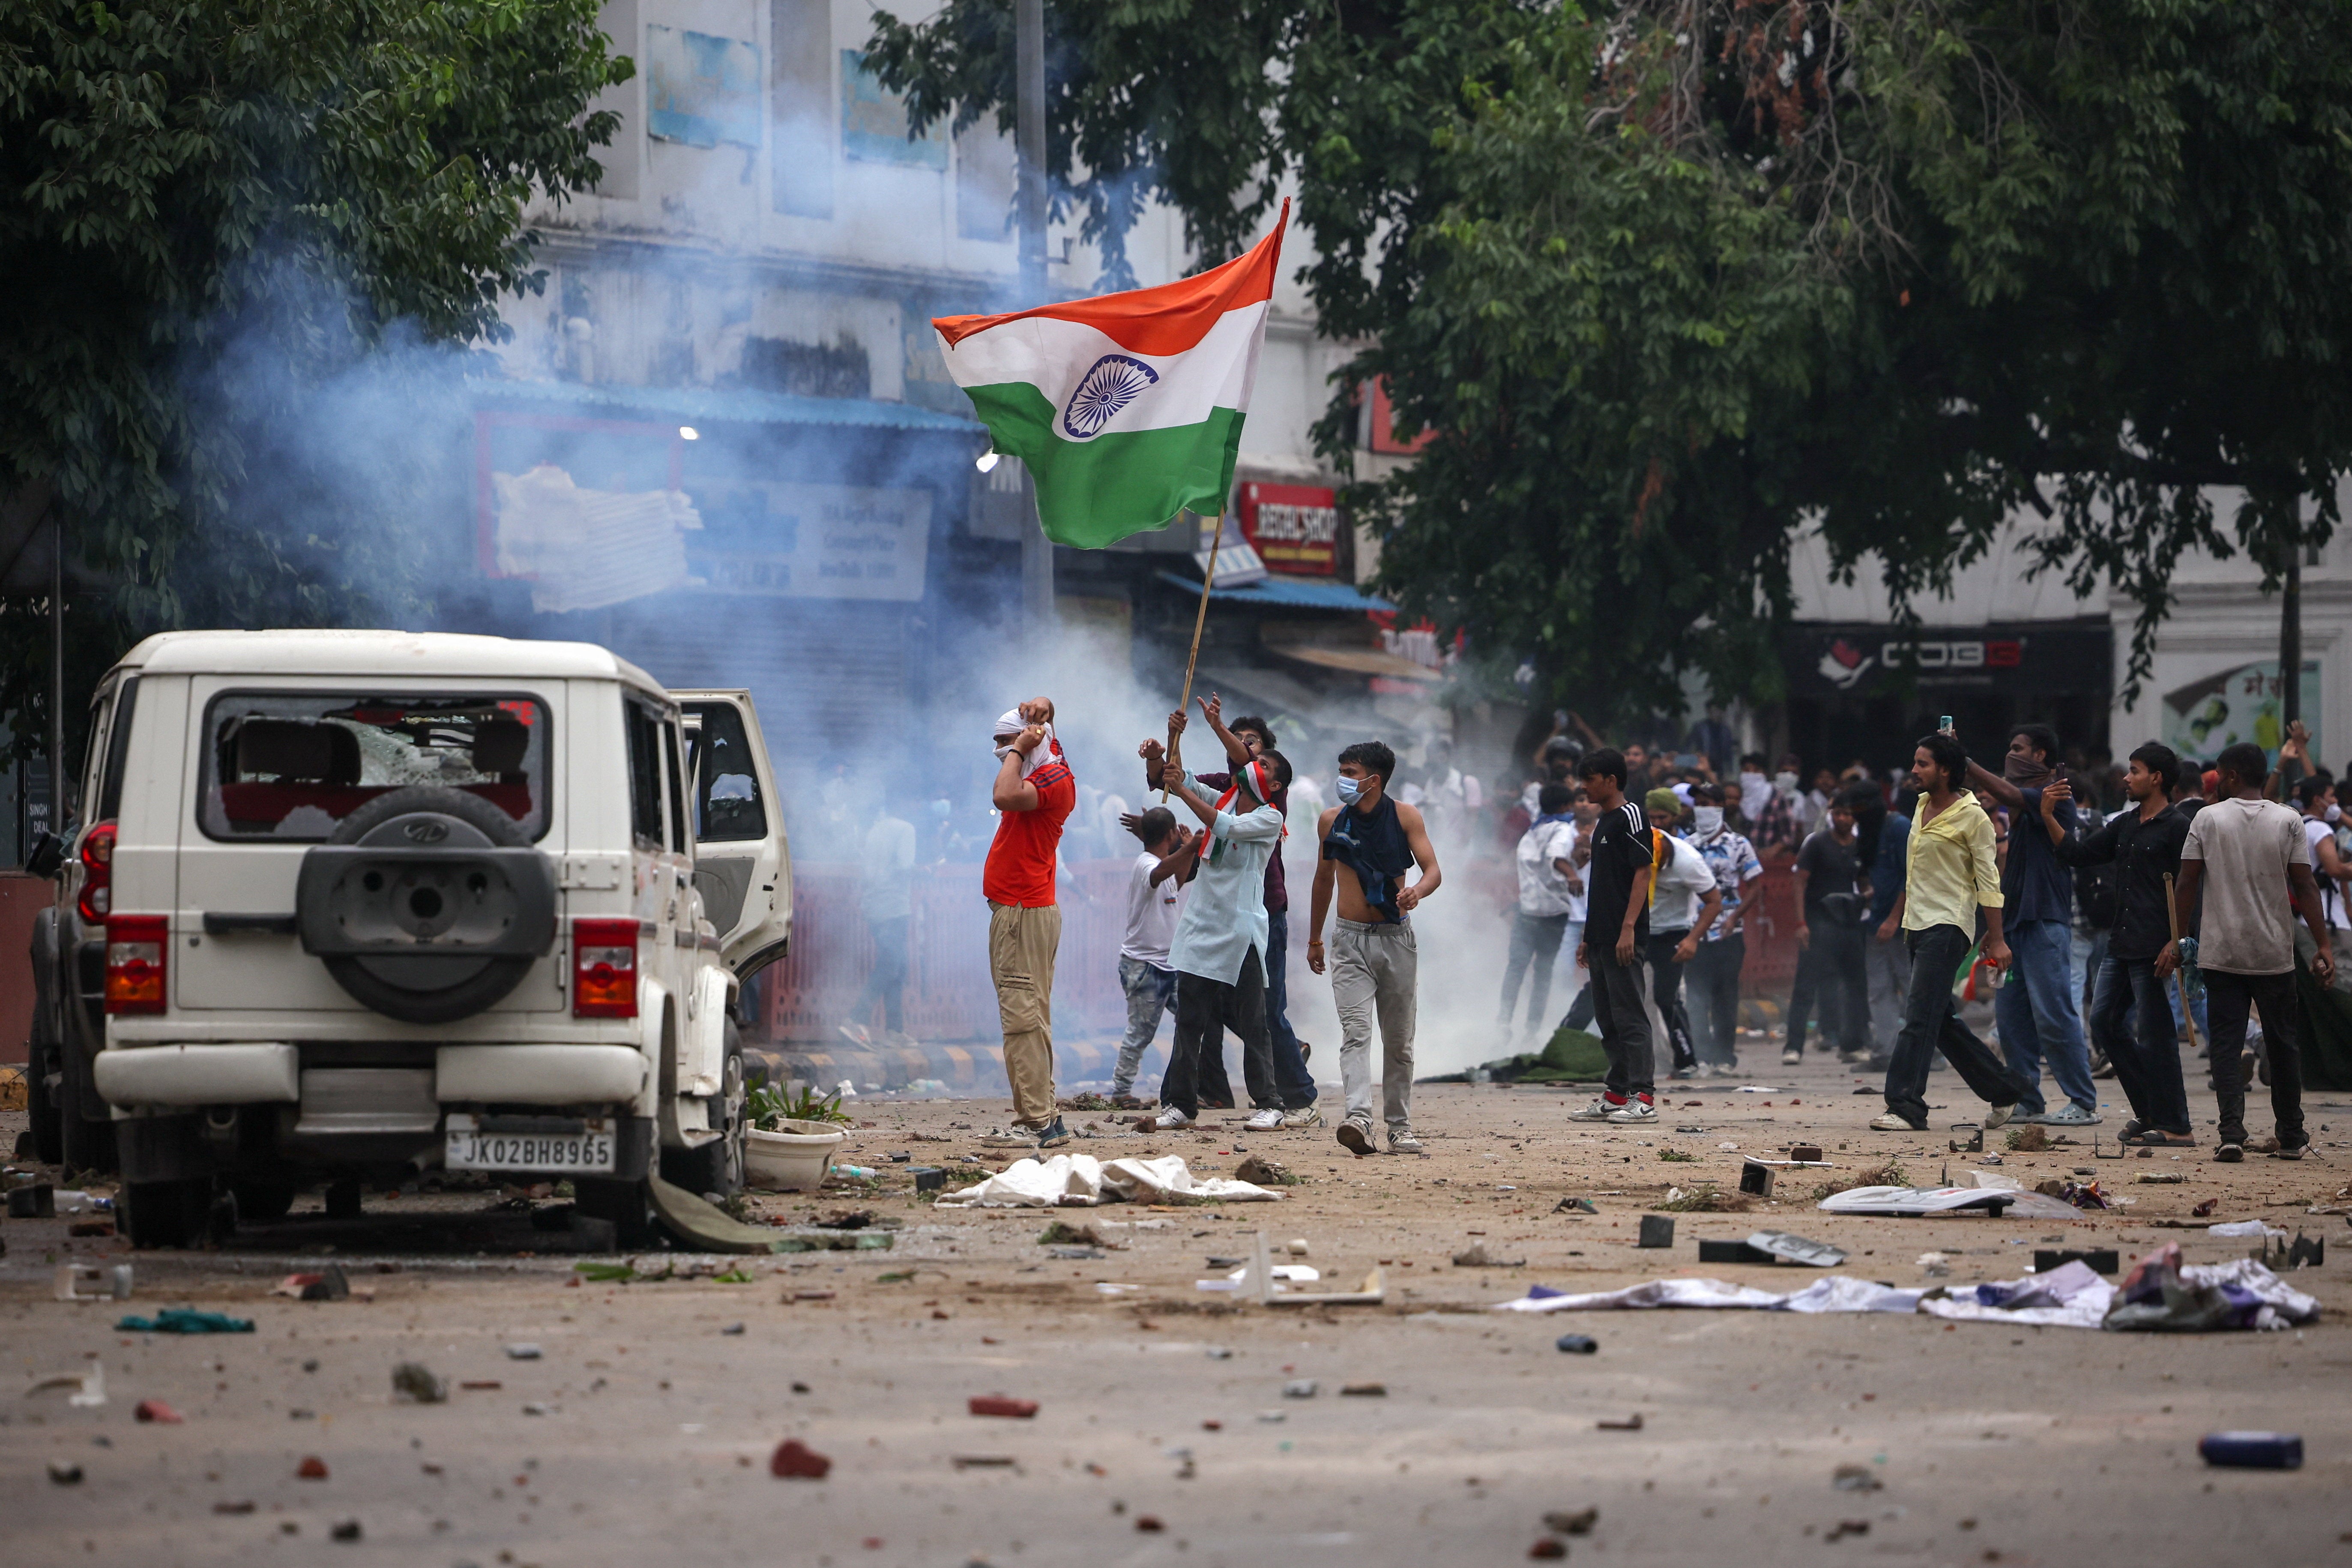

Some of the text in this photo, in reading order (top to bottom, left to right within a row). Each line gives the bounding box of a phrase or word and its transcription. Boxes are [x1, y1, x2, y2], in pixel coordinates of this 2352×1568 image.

[1881, 641, 2021, 668] COBB
[30, 803, 48, 816] SINGH
[464, 1138, 609, 1164] JK02BH8965
